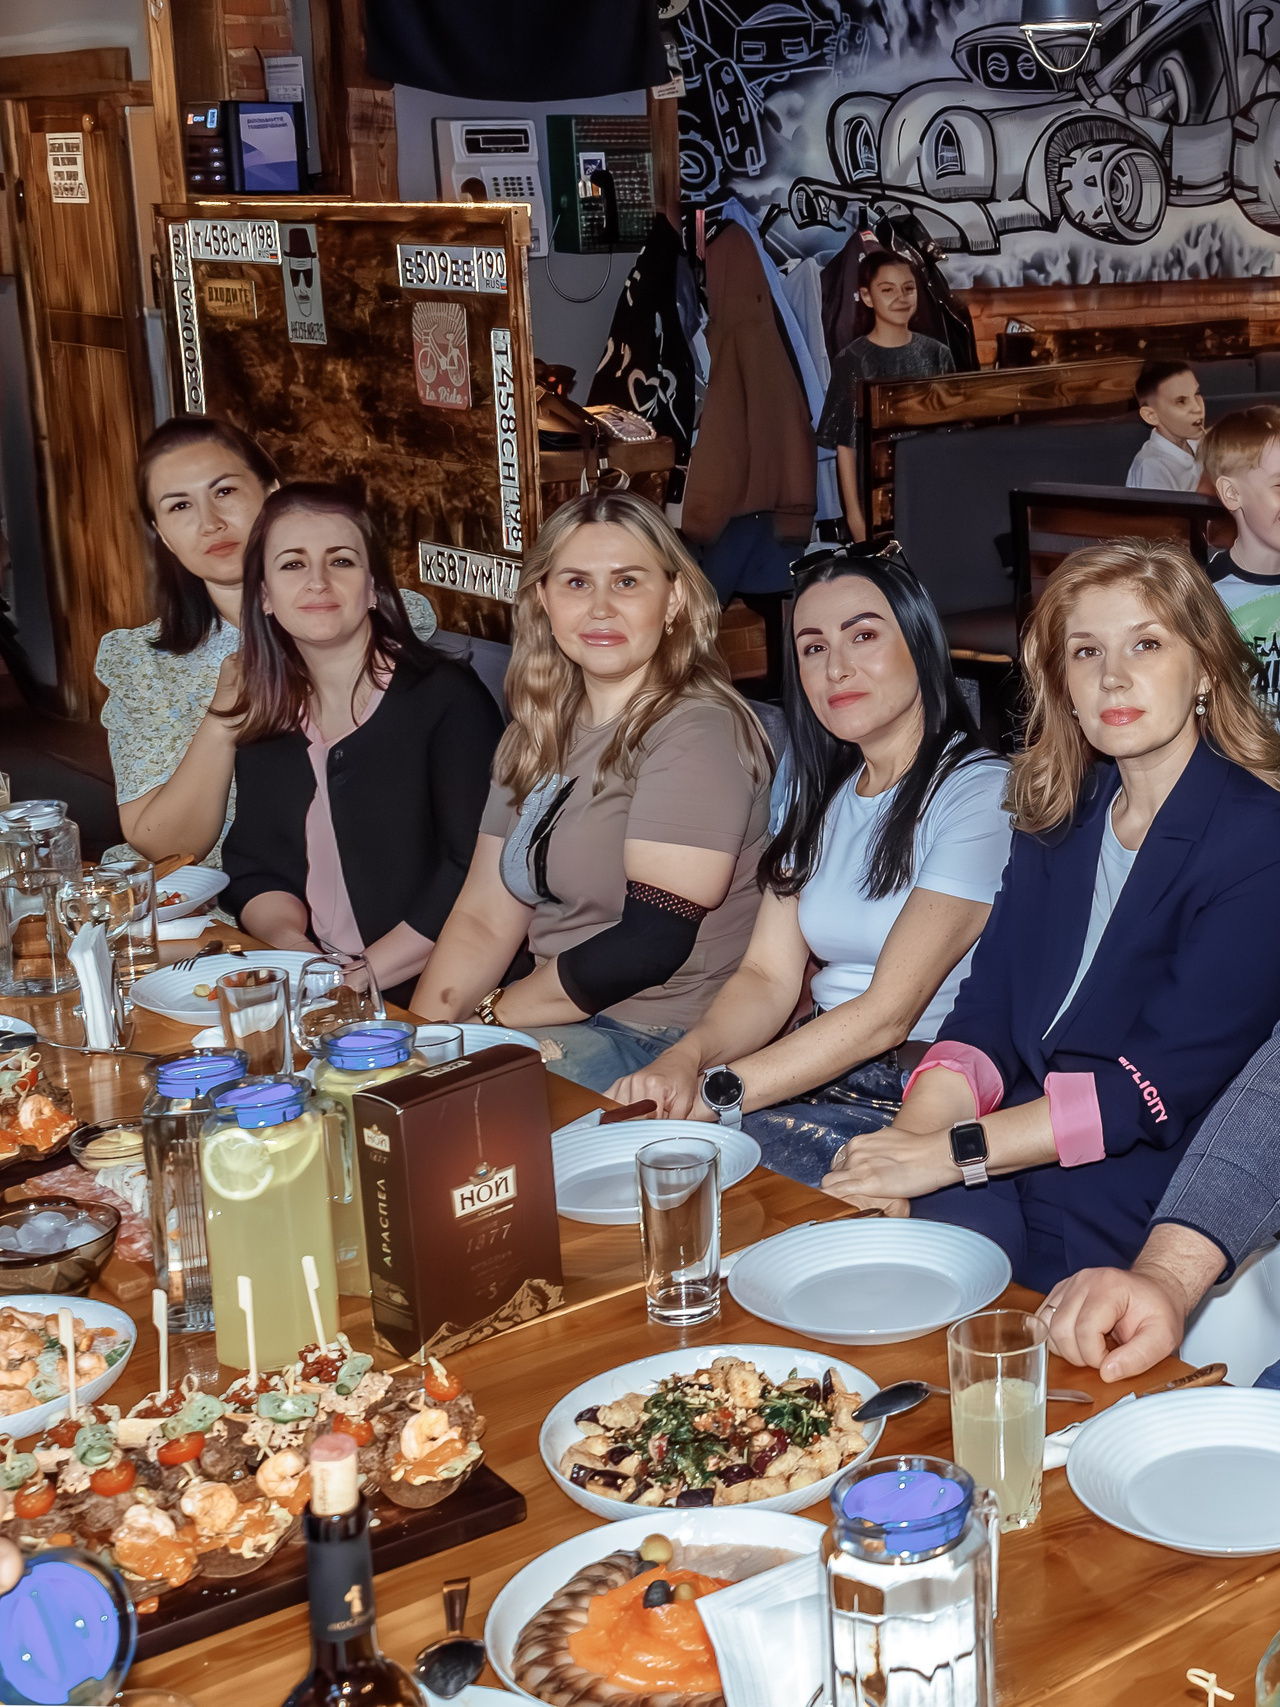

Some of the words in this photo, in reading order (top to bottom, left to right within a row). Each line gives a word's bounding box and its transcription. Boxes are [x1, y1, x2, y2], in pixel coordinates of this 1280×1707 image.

[252, 224, 276, 249] 198
[404, 250, 476, 287] E509EE
[477, 250, 507, 279] 190
[485, 279, 500, 289] RUS
[438, 386, 463, 405] Ride
[459, 1175, 510, 1211] НОЙ
